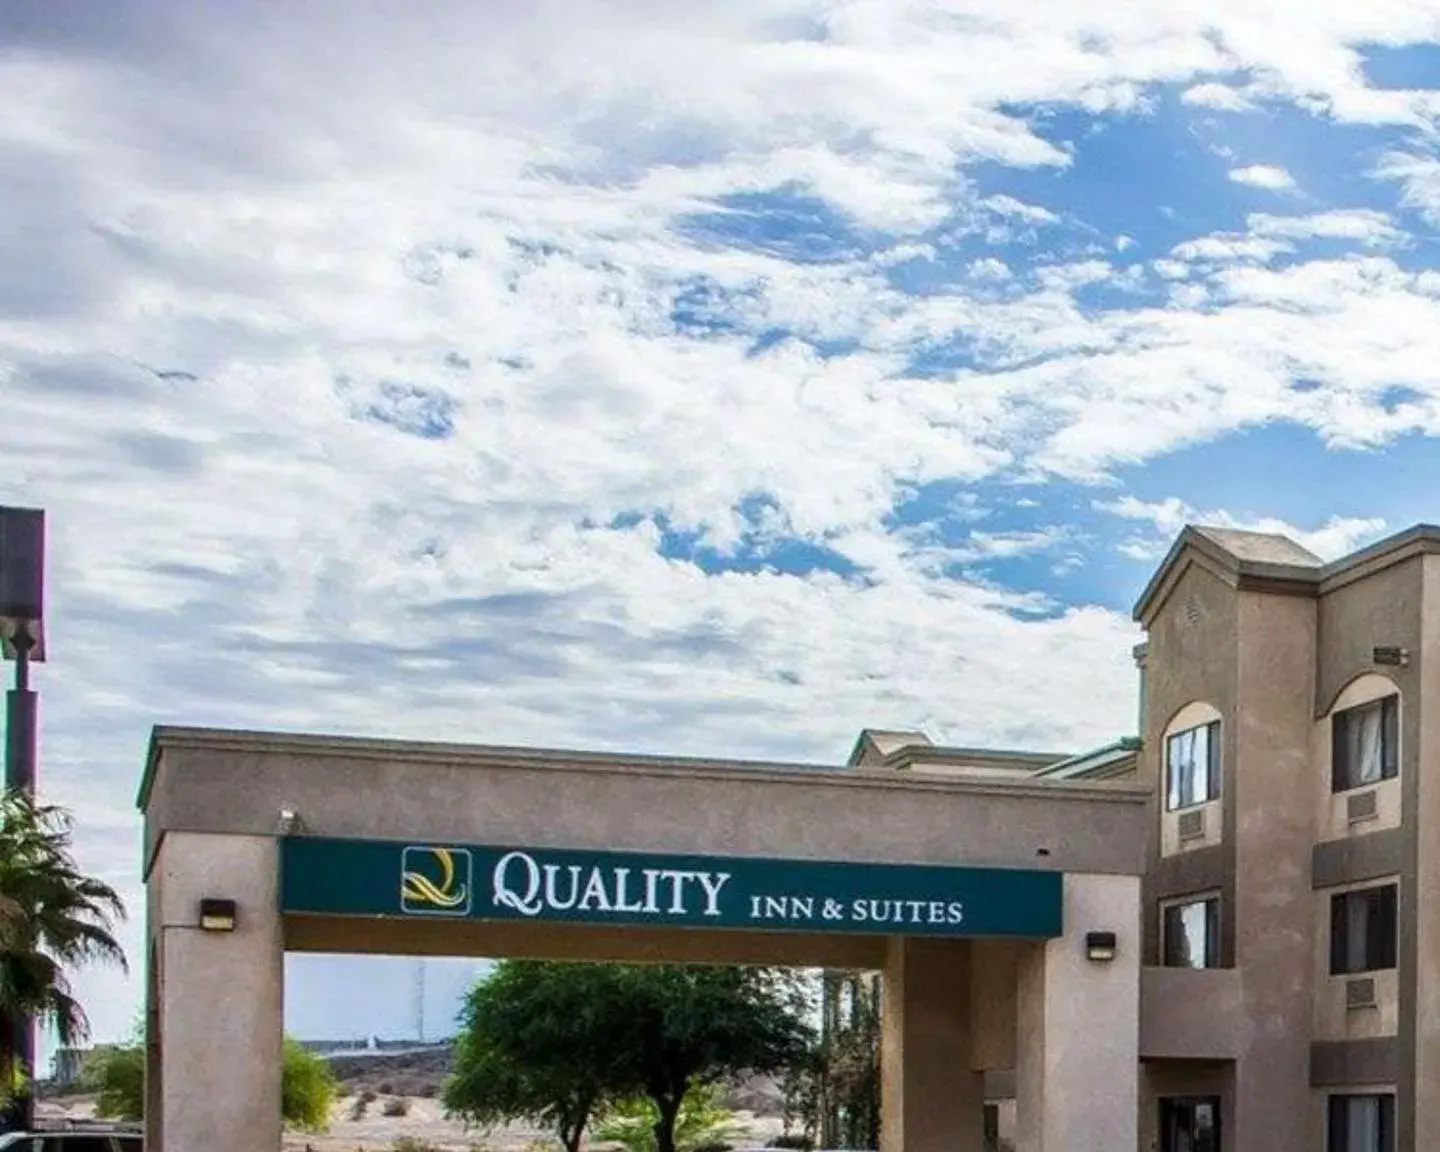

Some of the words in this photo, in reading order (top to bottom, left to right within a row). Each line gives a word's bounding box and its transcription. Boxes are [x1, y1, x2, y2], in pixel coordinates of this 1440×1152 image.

[492, 851, 732, 916] QUALITY
[750, 895, 814, 919] INN
[821, 897, 844, 920] &
[851, 899, 964, 924] SUITES
